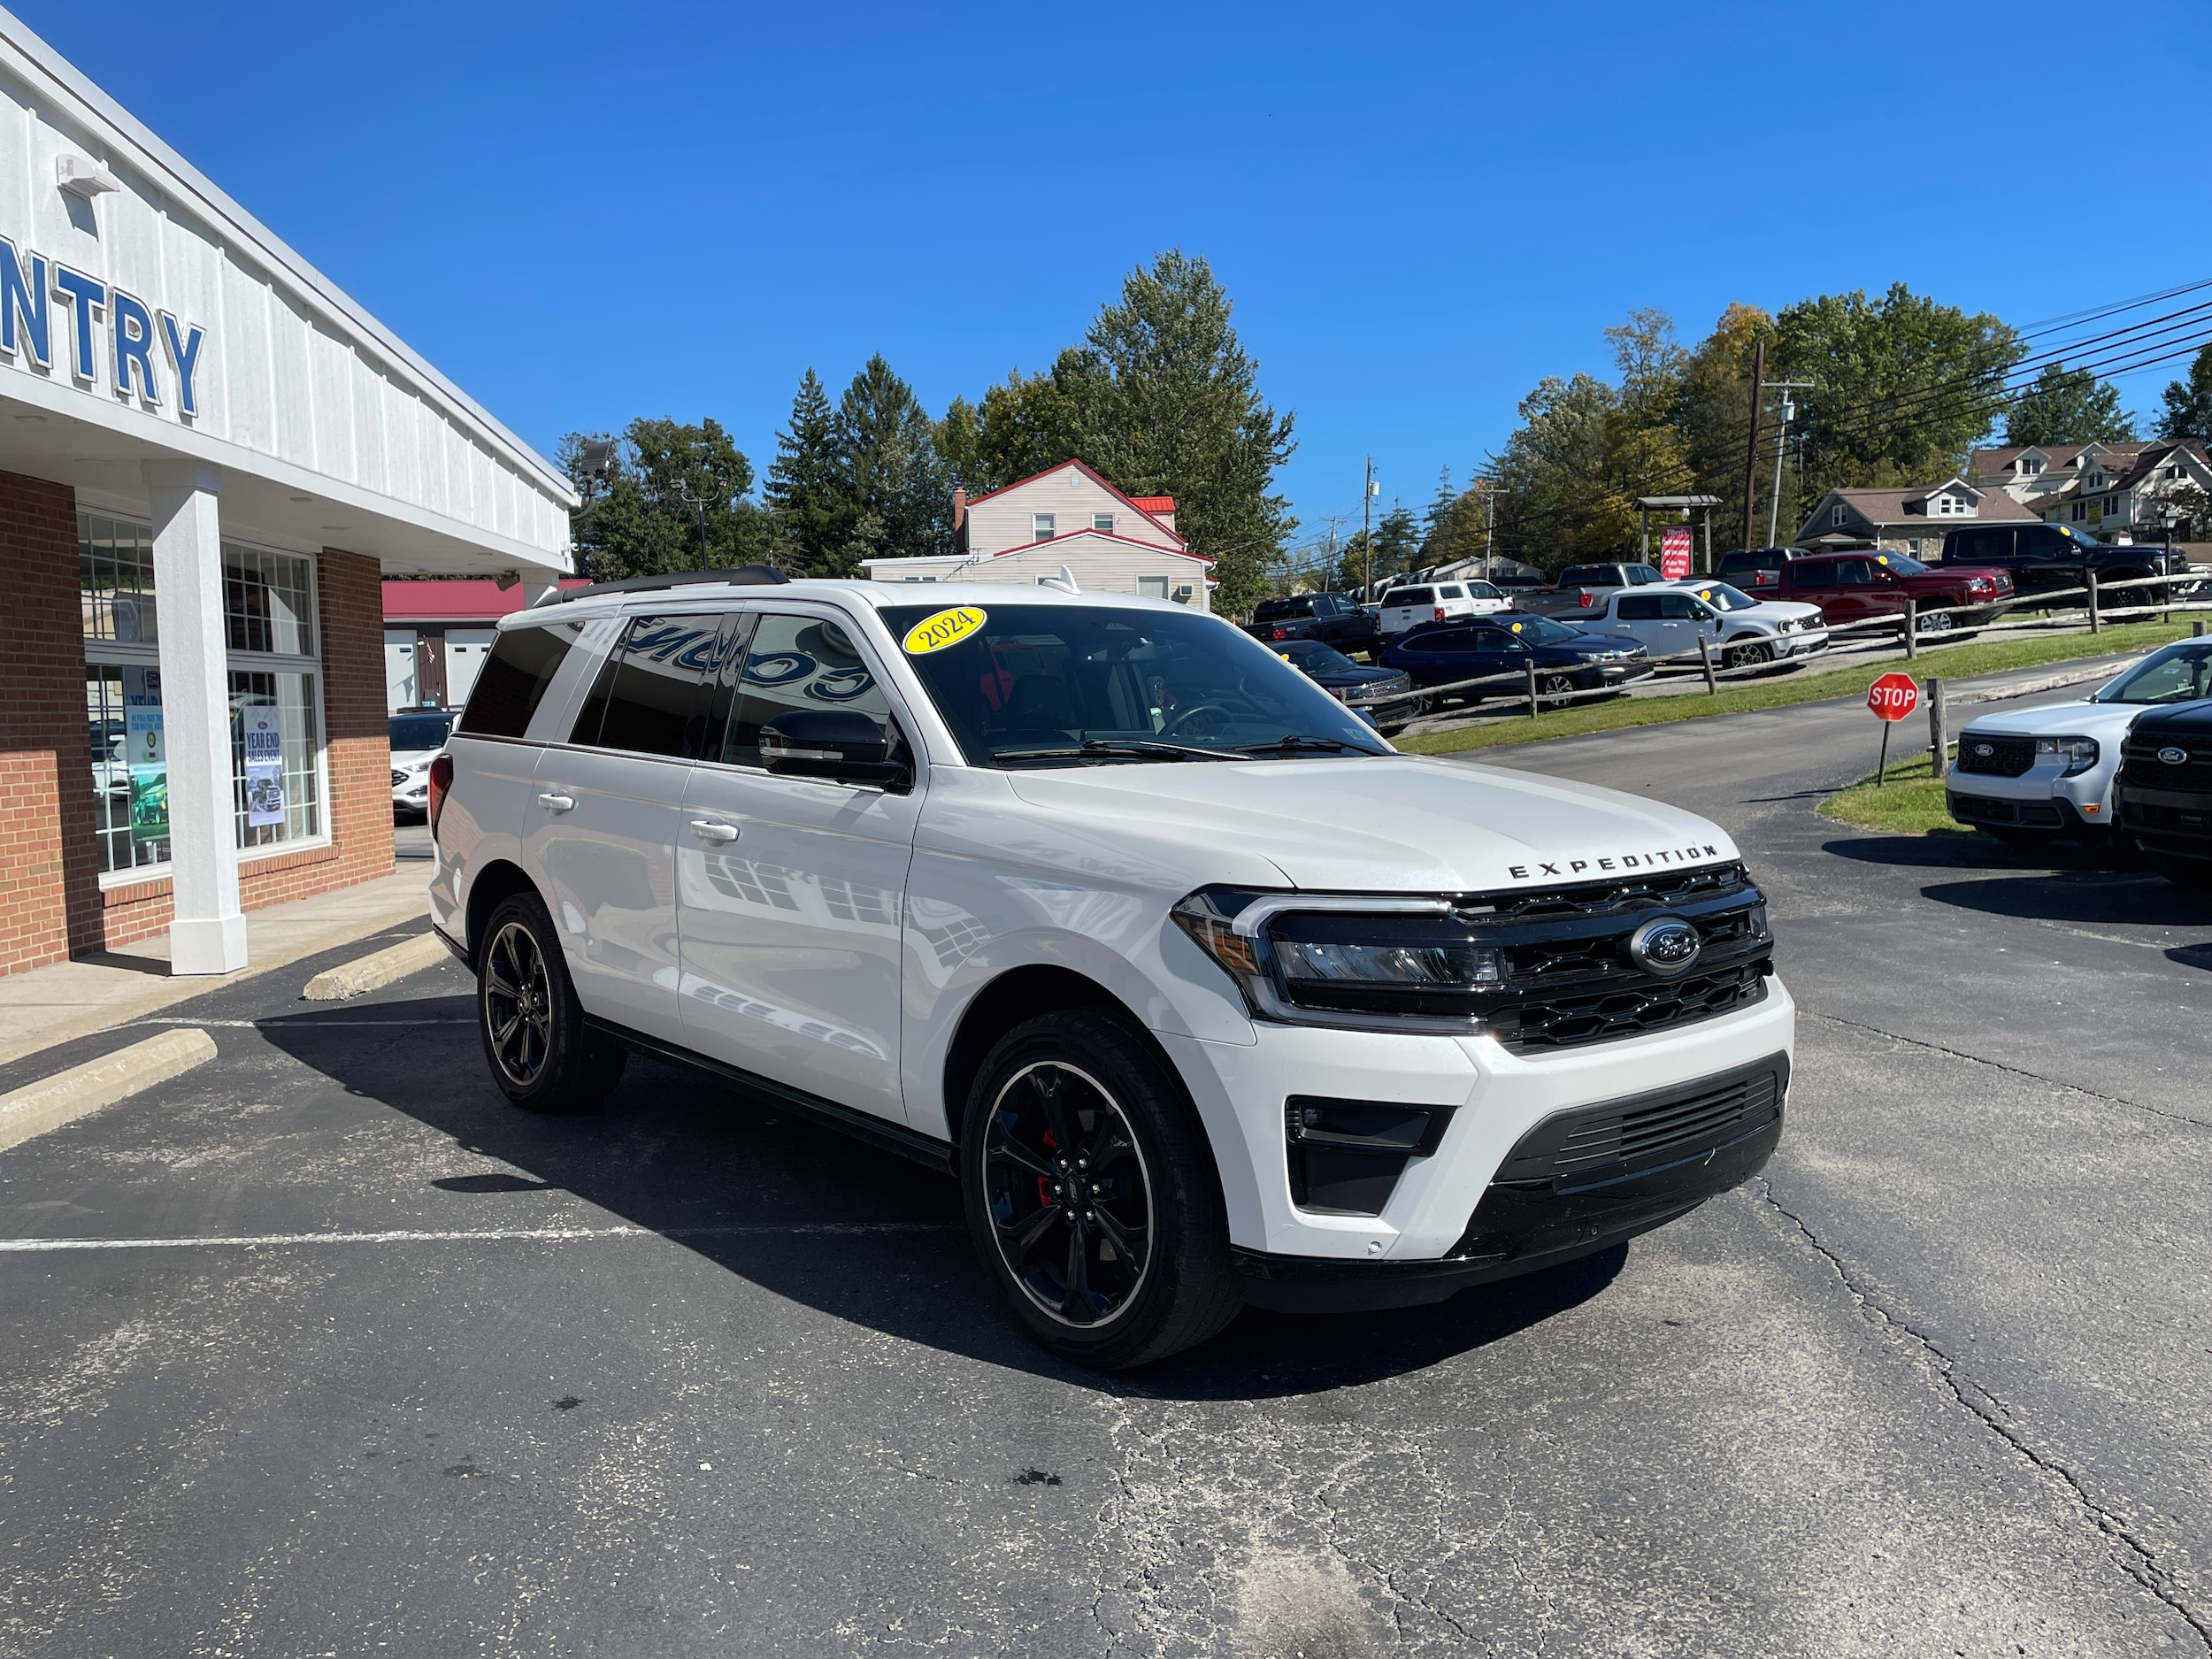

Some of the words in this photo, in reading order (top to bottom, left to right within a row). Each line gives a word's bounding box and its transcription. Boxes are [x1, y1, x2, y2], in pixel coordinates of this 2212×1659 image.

[0, 234, 207, 418] NTRY
[918, 611, 976, 648] 2024
[1870, 687, 1916, 707] STOP
[246, 732, 265, 749] YEAR
[265, 732, 280, 749] END
[248, 749, 264, 762] SALES
[265, 749, 280, 761] EVENT
[1508, 844, 1717, 879] EXPEDITION
